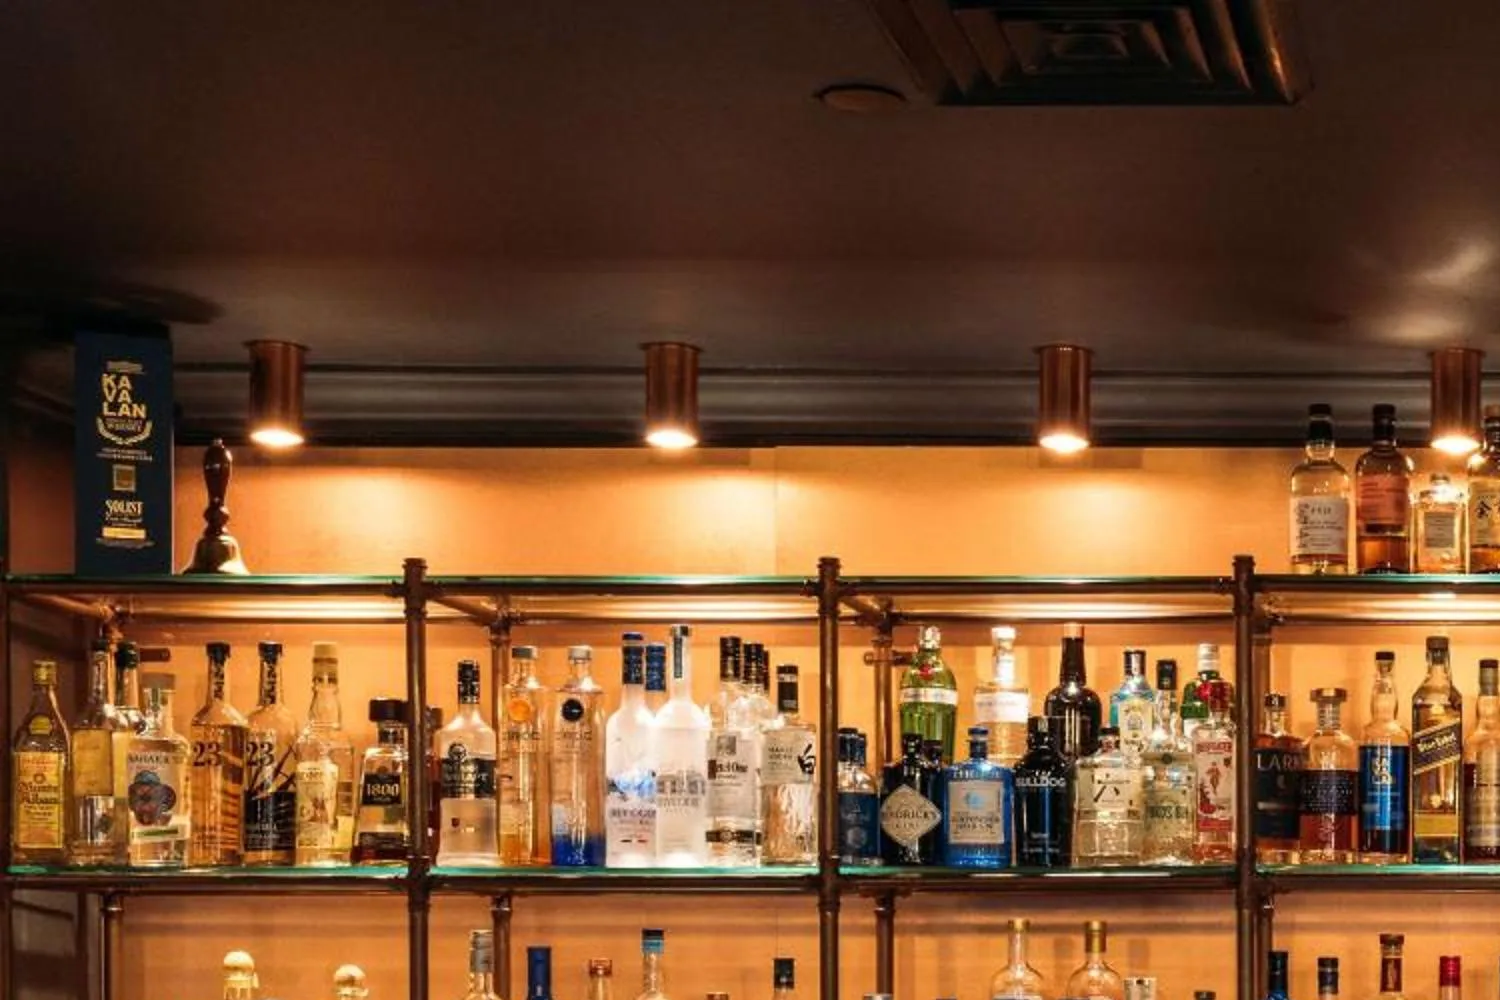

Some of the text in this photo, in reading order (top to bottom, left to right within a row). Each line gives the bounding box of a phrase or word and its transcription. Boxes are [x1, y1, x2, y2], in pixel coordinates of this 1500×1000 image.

[193, 741, 222, 767] 23
[246, 741, 275, 767] 23
[365, 783, 400, 797] 1800
